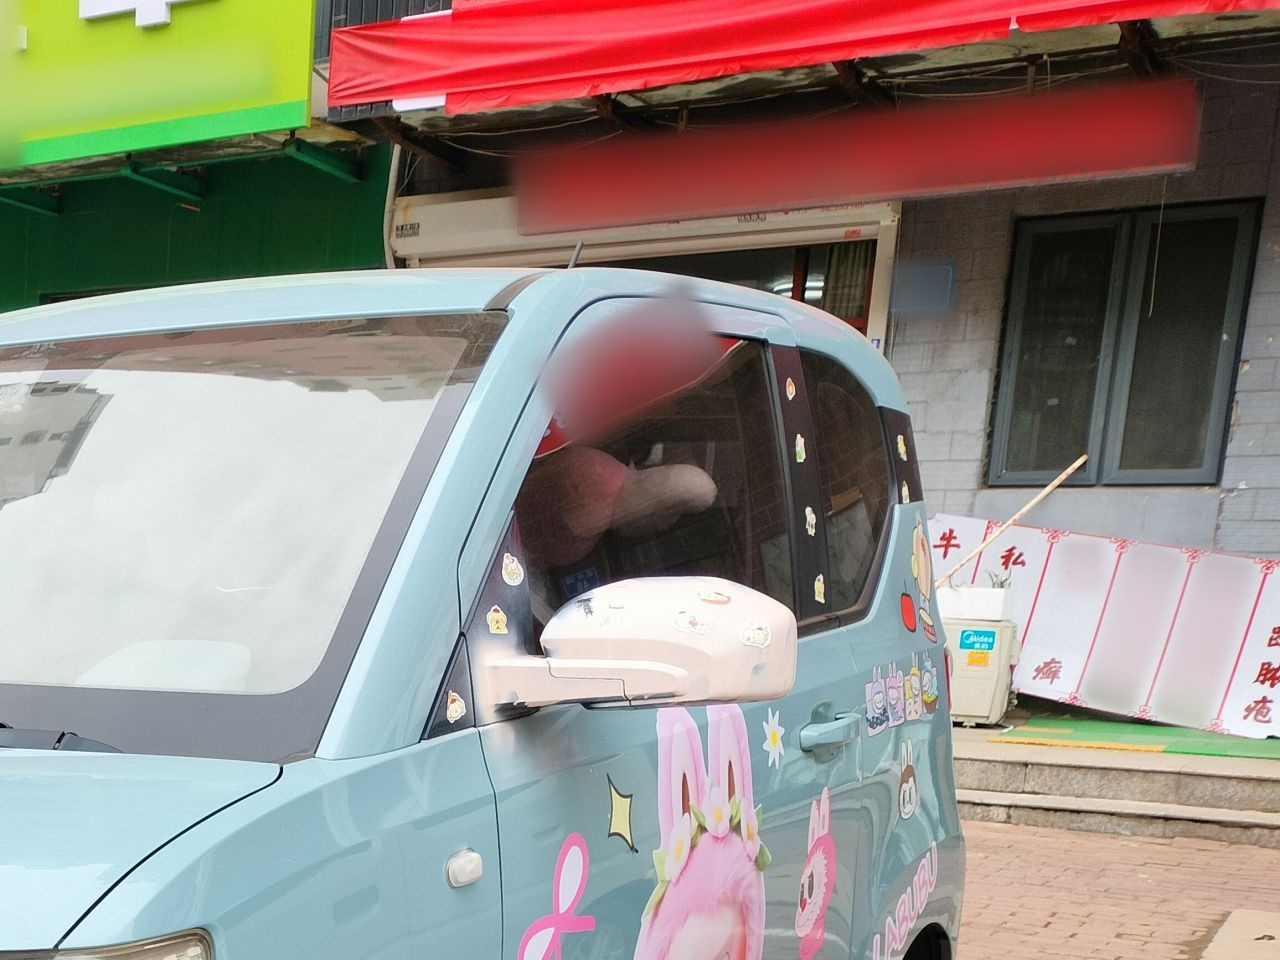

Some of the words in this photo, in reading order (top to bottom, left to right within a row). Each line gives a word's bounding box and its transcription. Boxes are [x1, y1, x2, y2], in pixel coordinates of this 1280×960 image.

[933, 528, 961, 560] 牛
[1000, 545, 1026, 570] 私
[1032, 657, 1062, 685] 癣
